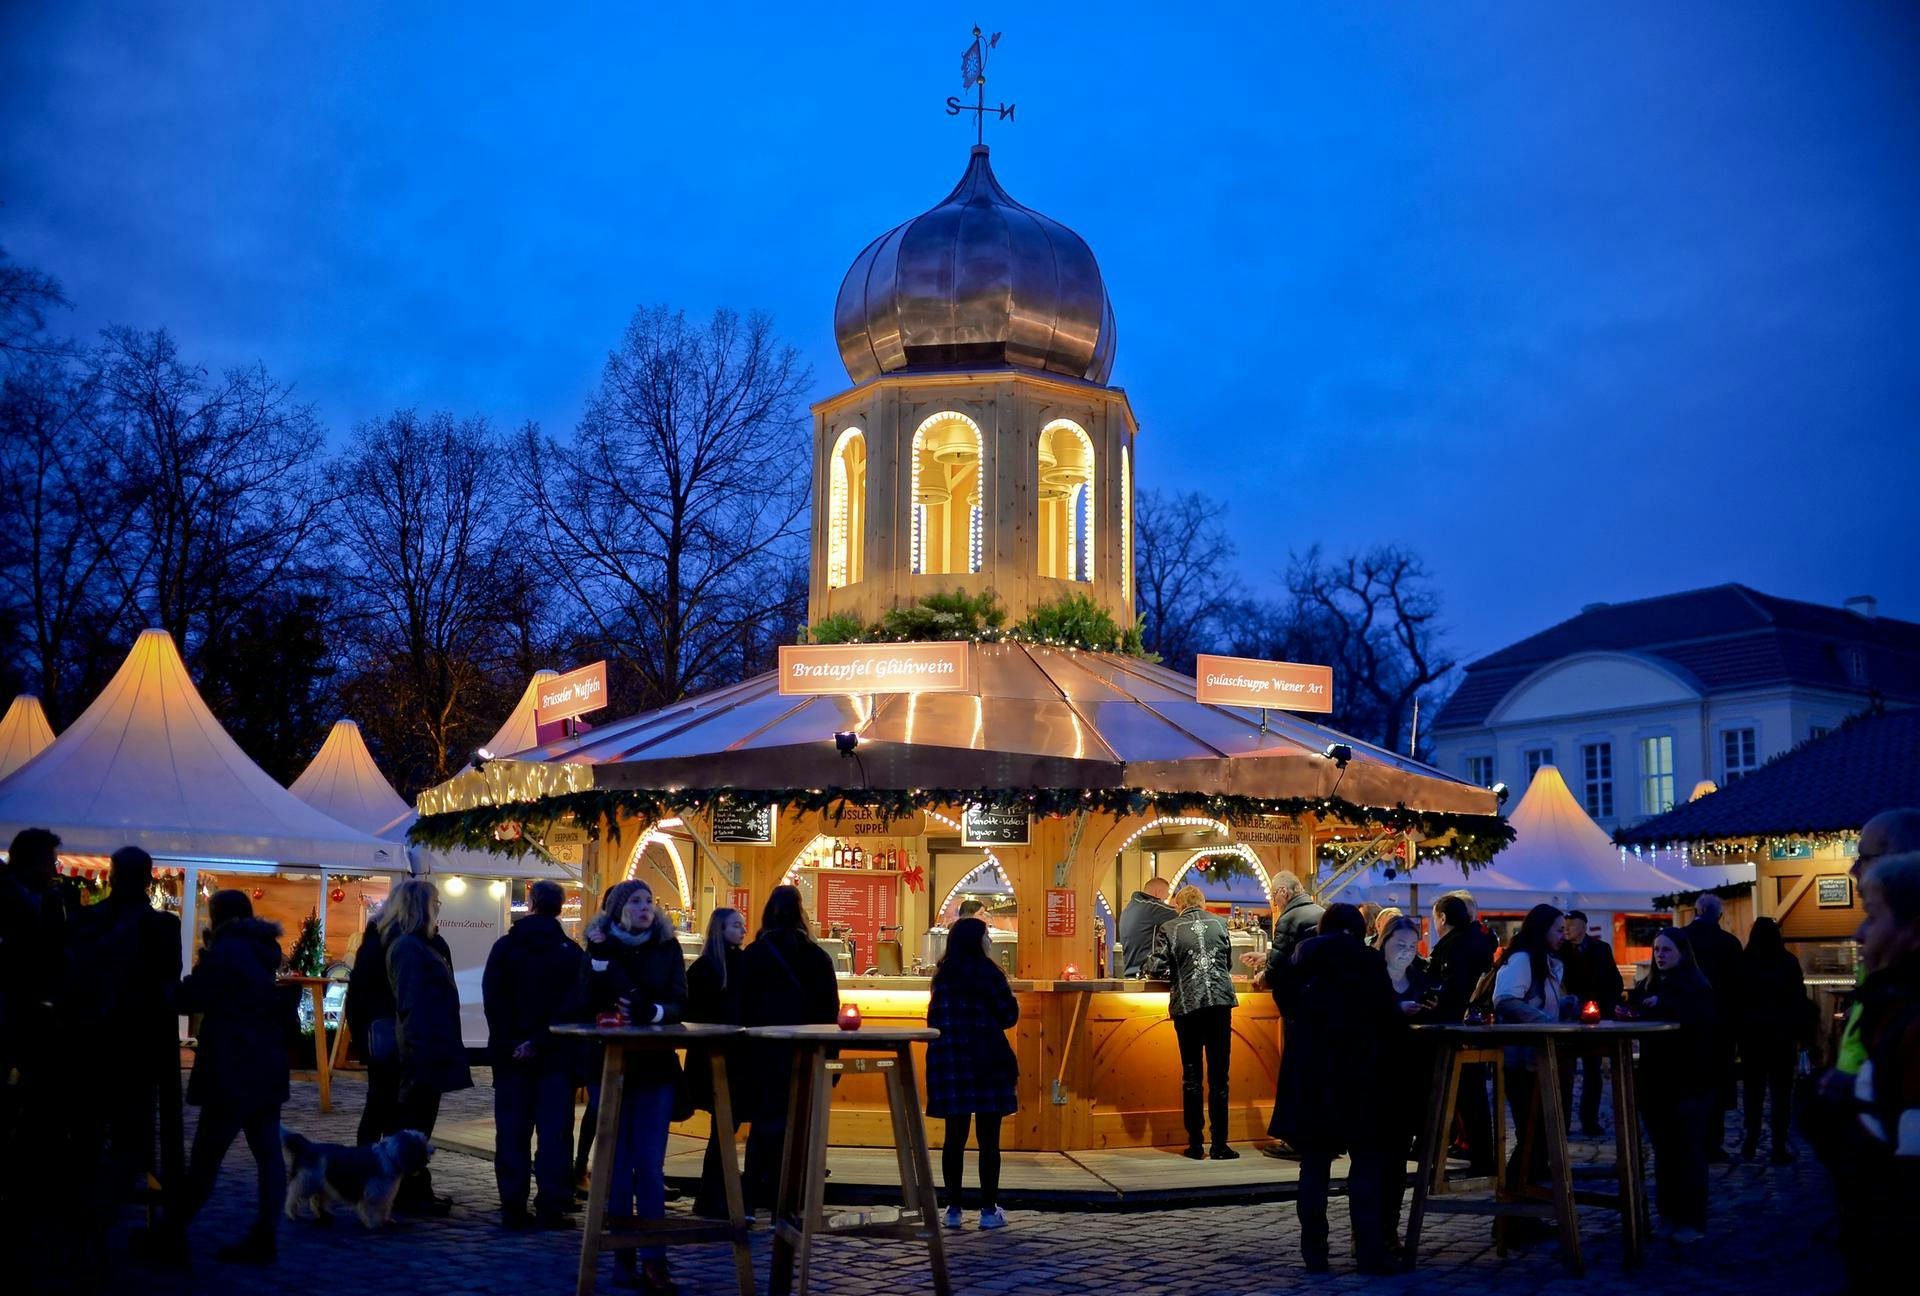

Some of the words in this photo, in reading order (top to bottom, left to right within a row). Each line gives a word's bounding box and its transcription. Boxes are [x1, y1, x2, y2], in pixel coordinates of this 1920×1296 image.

[946, 96, 960, 115] S
[792, 659, 871, 680] Bratapfel
[875, 658, 954, 678] Glühwein
[573, 676, 600, 700] Waffeln
[1206, 673, 1269, 692] Gulaschsuppe
[1271, 678, 1305, 692] Wiener
[1306, 682, 1323, 694] Art
[854, 823, 889, 834] SUPPEN
